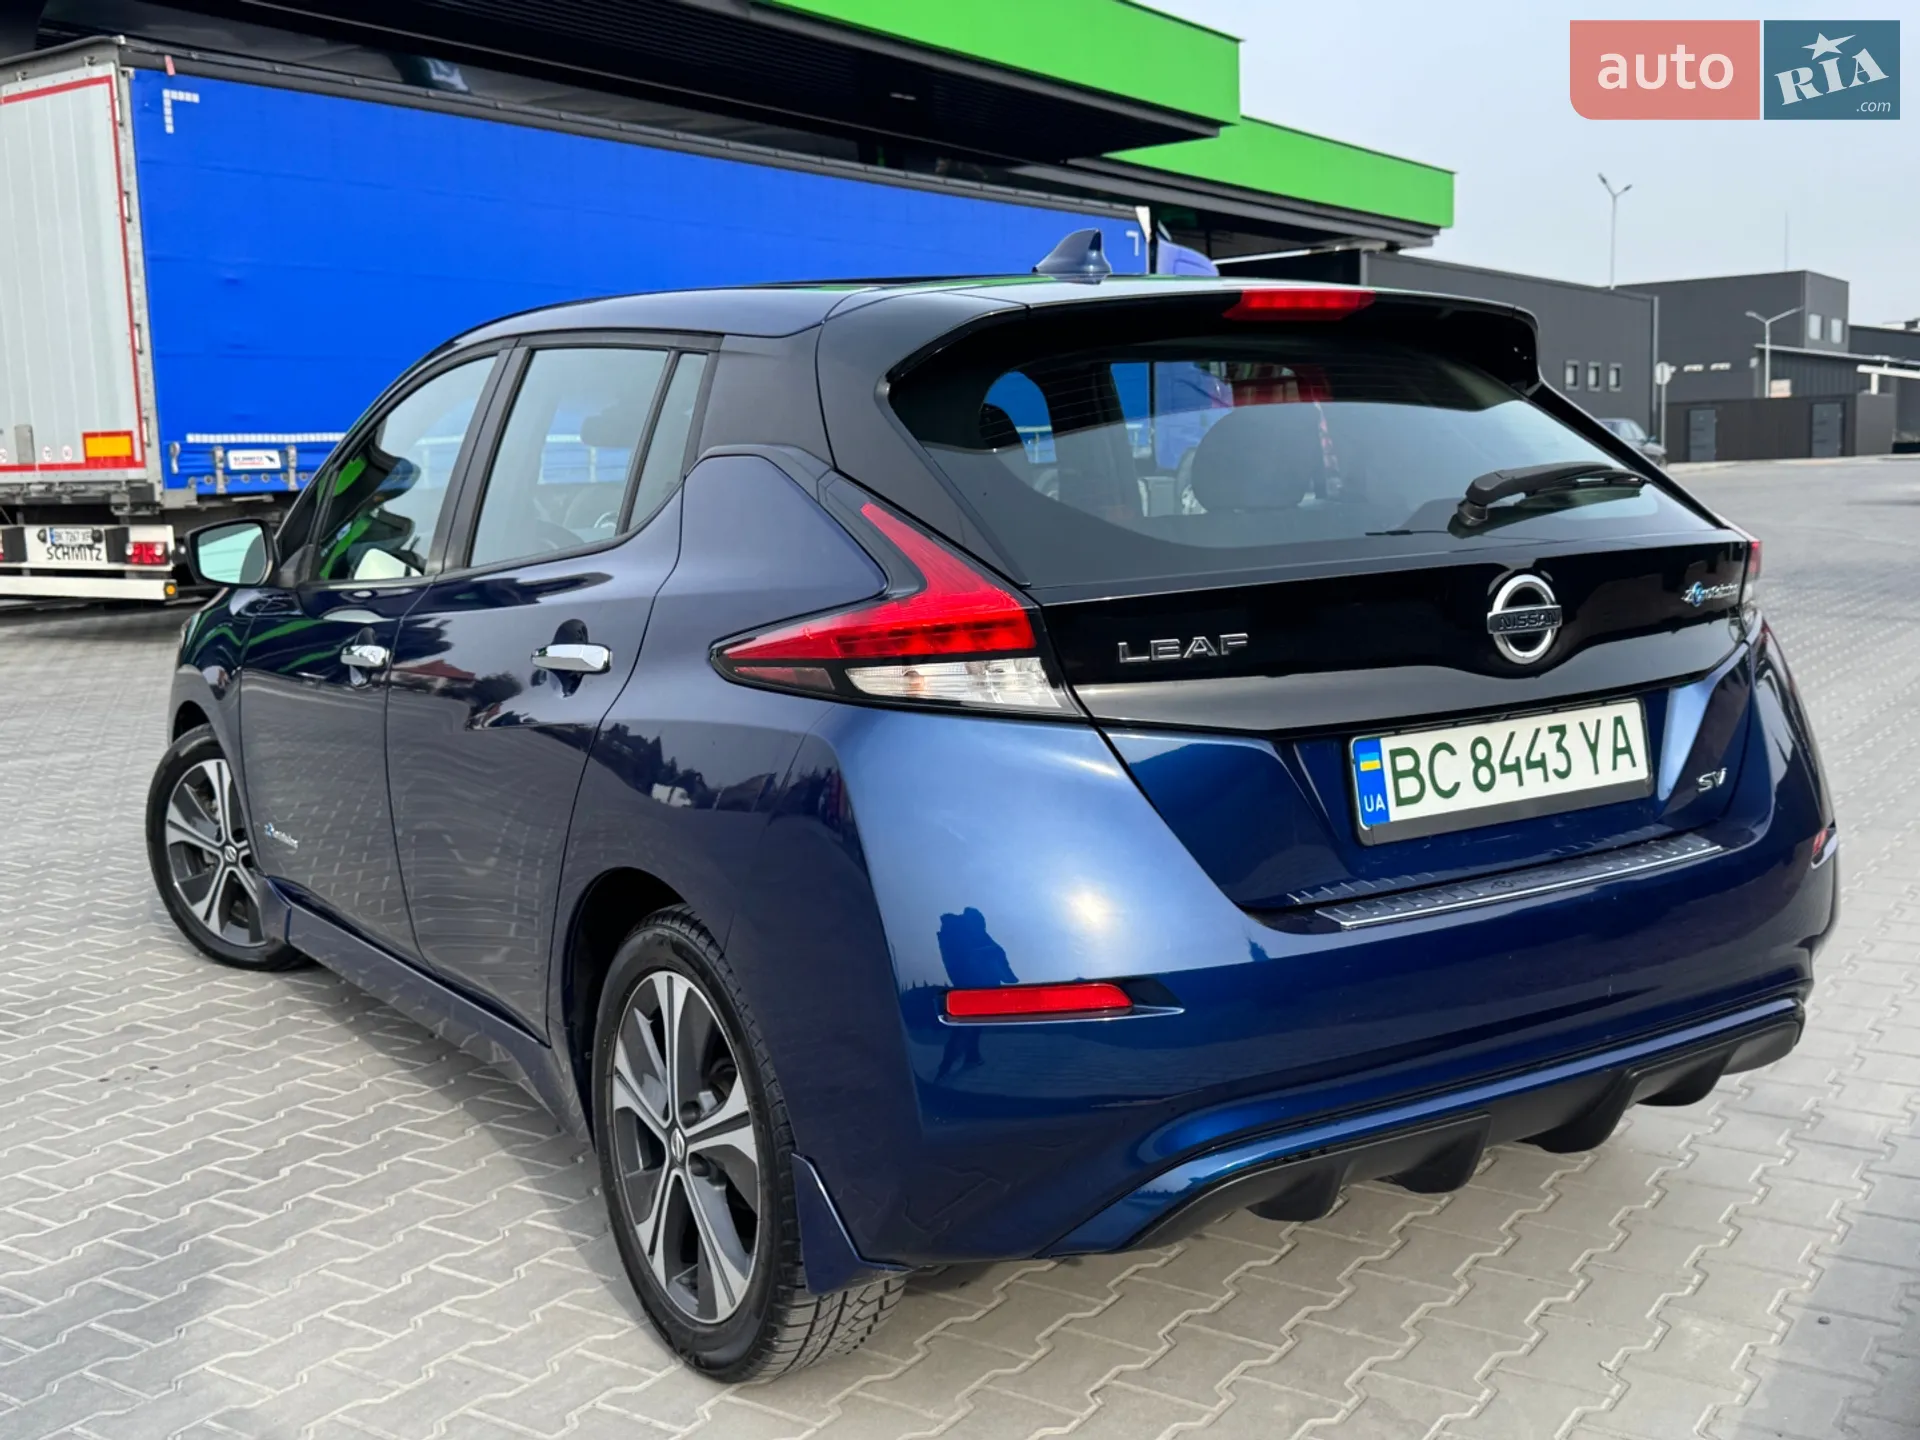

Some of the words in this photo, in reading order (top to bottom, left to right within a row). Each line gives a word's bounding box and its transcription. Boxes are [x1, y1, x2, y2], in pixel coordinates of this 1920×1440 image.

[46, 545, 102, 561] SCHMITZ
[1499, 609, 1559, 630] NISSAN
[1117, 632, 1249, 663] LEAF
[1388, 742, 1461, 808] BC
[1469, 724, 1572, 793] 8443
[1579, 715, 1638, 776] YA
[1697, 767, 1727, 792] SV
[1364, 793, 1386, 812] UA
